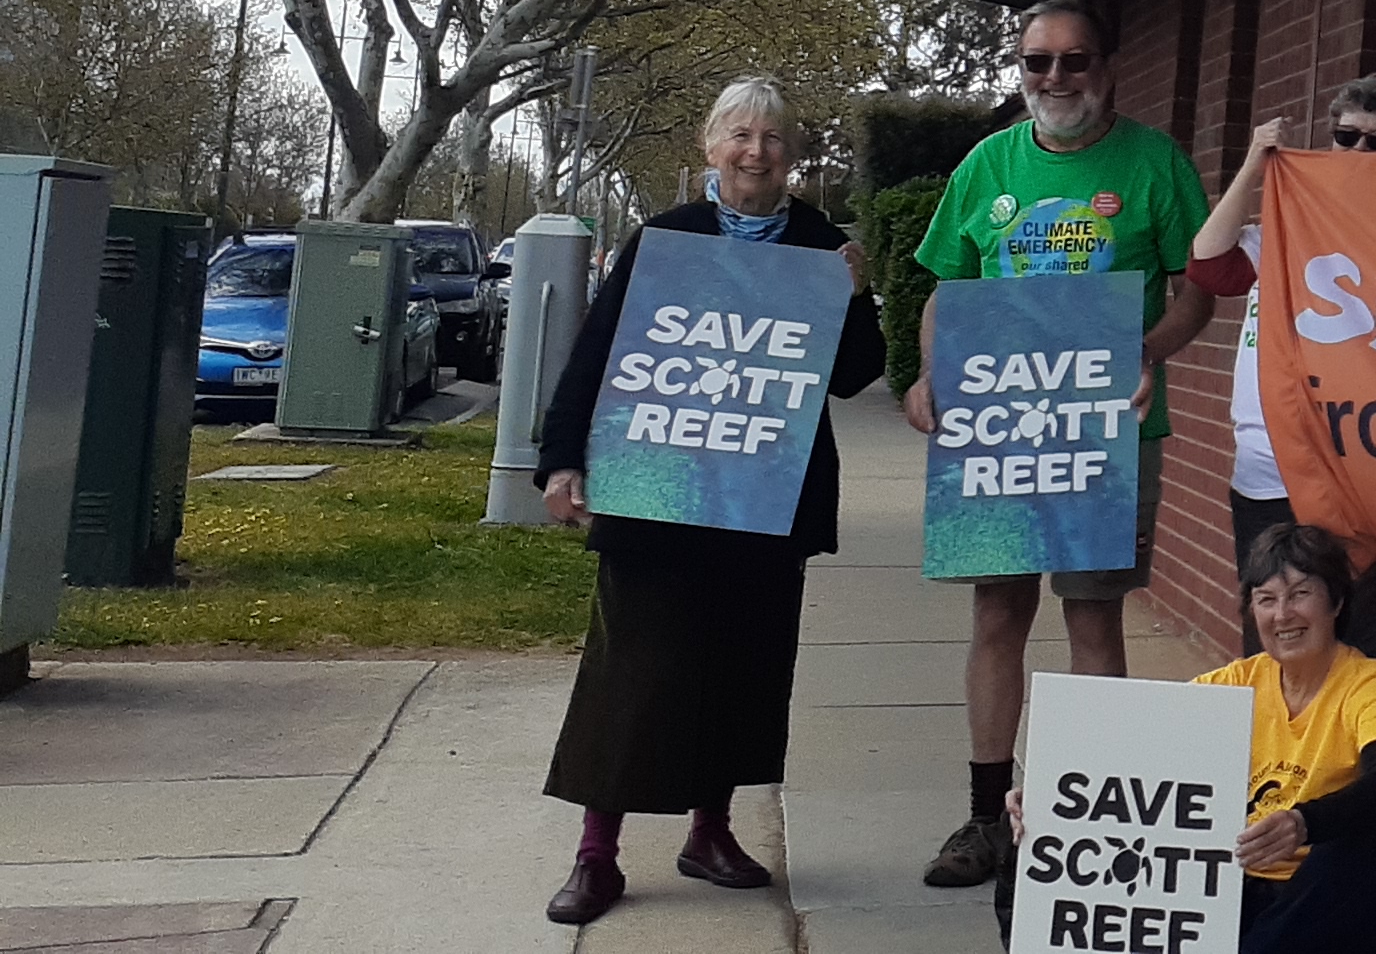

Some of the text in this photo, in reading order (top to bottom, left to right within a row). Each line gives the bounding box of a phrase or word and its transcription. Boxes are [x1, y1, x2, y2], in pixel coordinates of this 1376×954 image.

[1008, 238, 1107, 255] EMERGENCY
[1023, 221, 1093, 237] CLIMATE
[1021, 258, 1089, 272] our shared
[646, 305, 811, 359] SAVE
[959, 349, 1112, 395] SAVE
[626, 402, 786, 454] REEF
[961, 450, 1108, 497] REEF
[1051, 772, 1213, 830] SAVE
[1049, 899, 1205, 954] REEF
